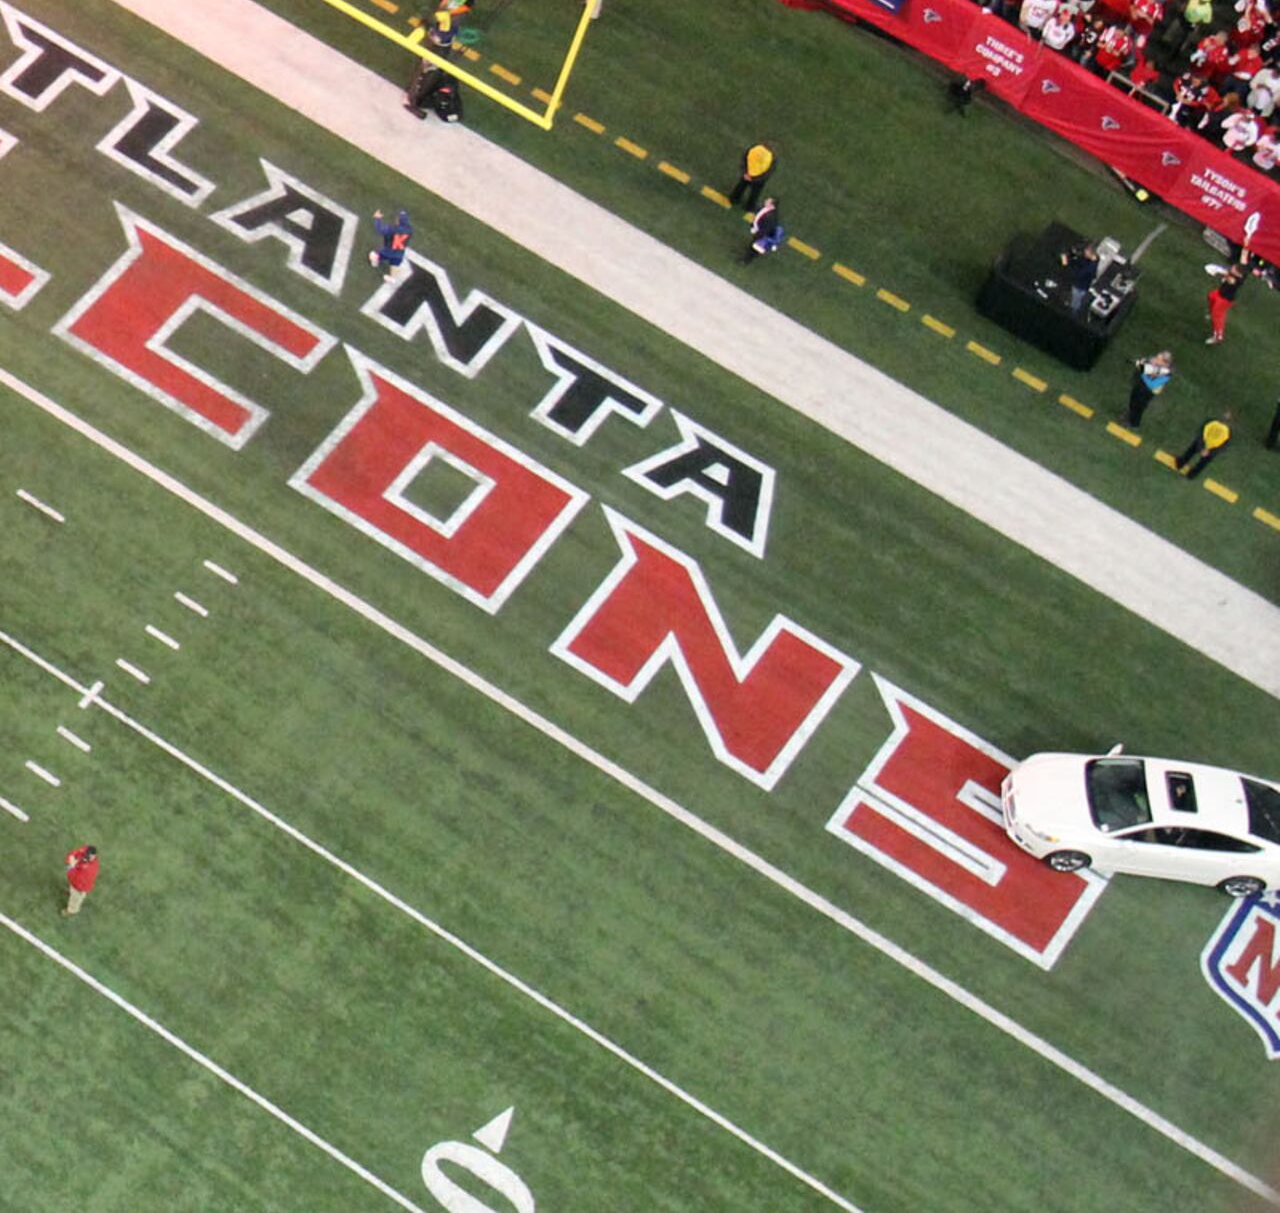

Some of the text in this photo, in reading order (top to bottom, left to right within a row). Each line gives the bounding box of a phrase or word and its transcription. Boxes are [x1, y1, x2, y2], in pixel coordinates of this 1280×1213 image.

[975, 44, 1023, 76] COMPANY
[986, 36, 1024, 64] THREE'S
[392, 234, 409, 250] K
